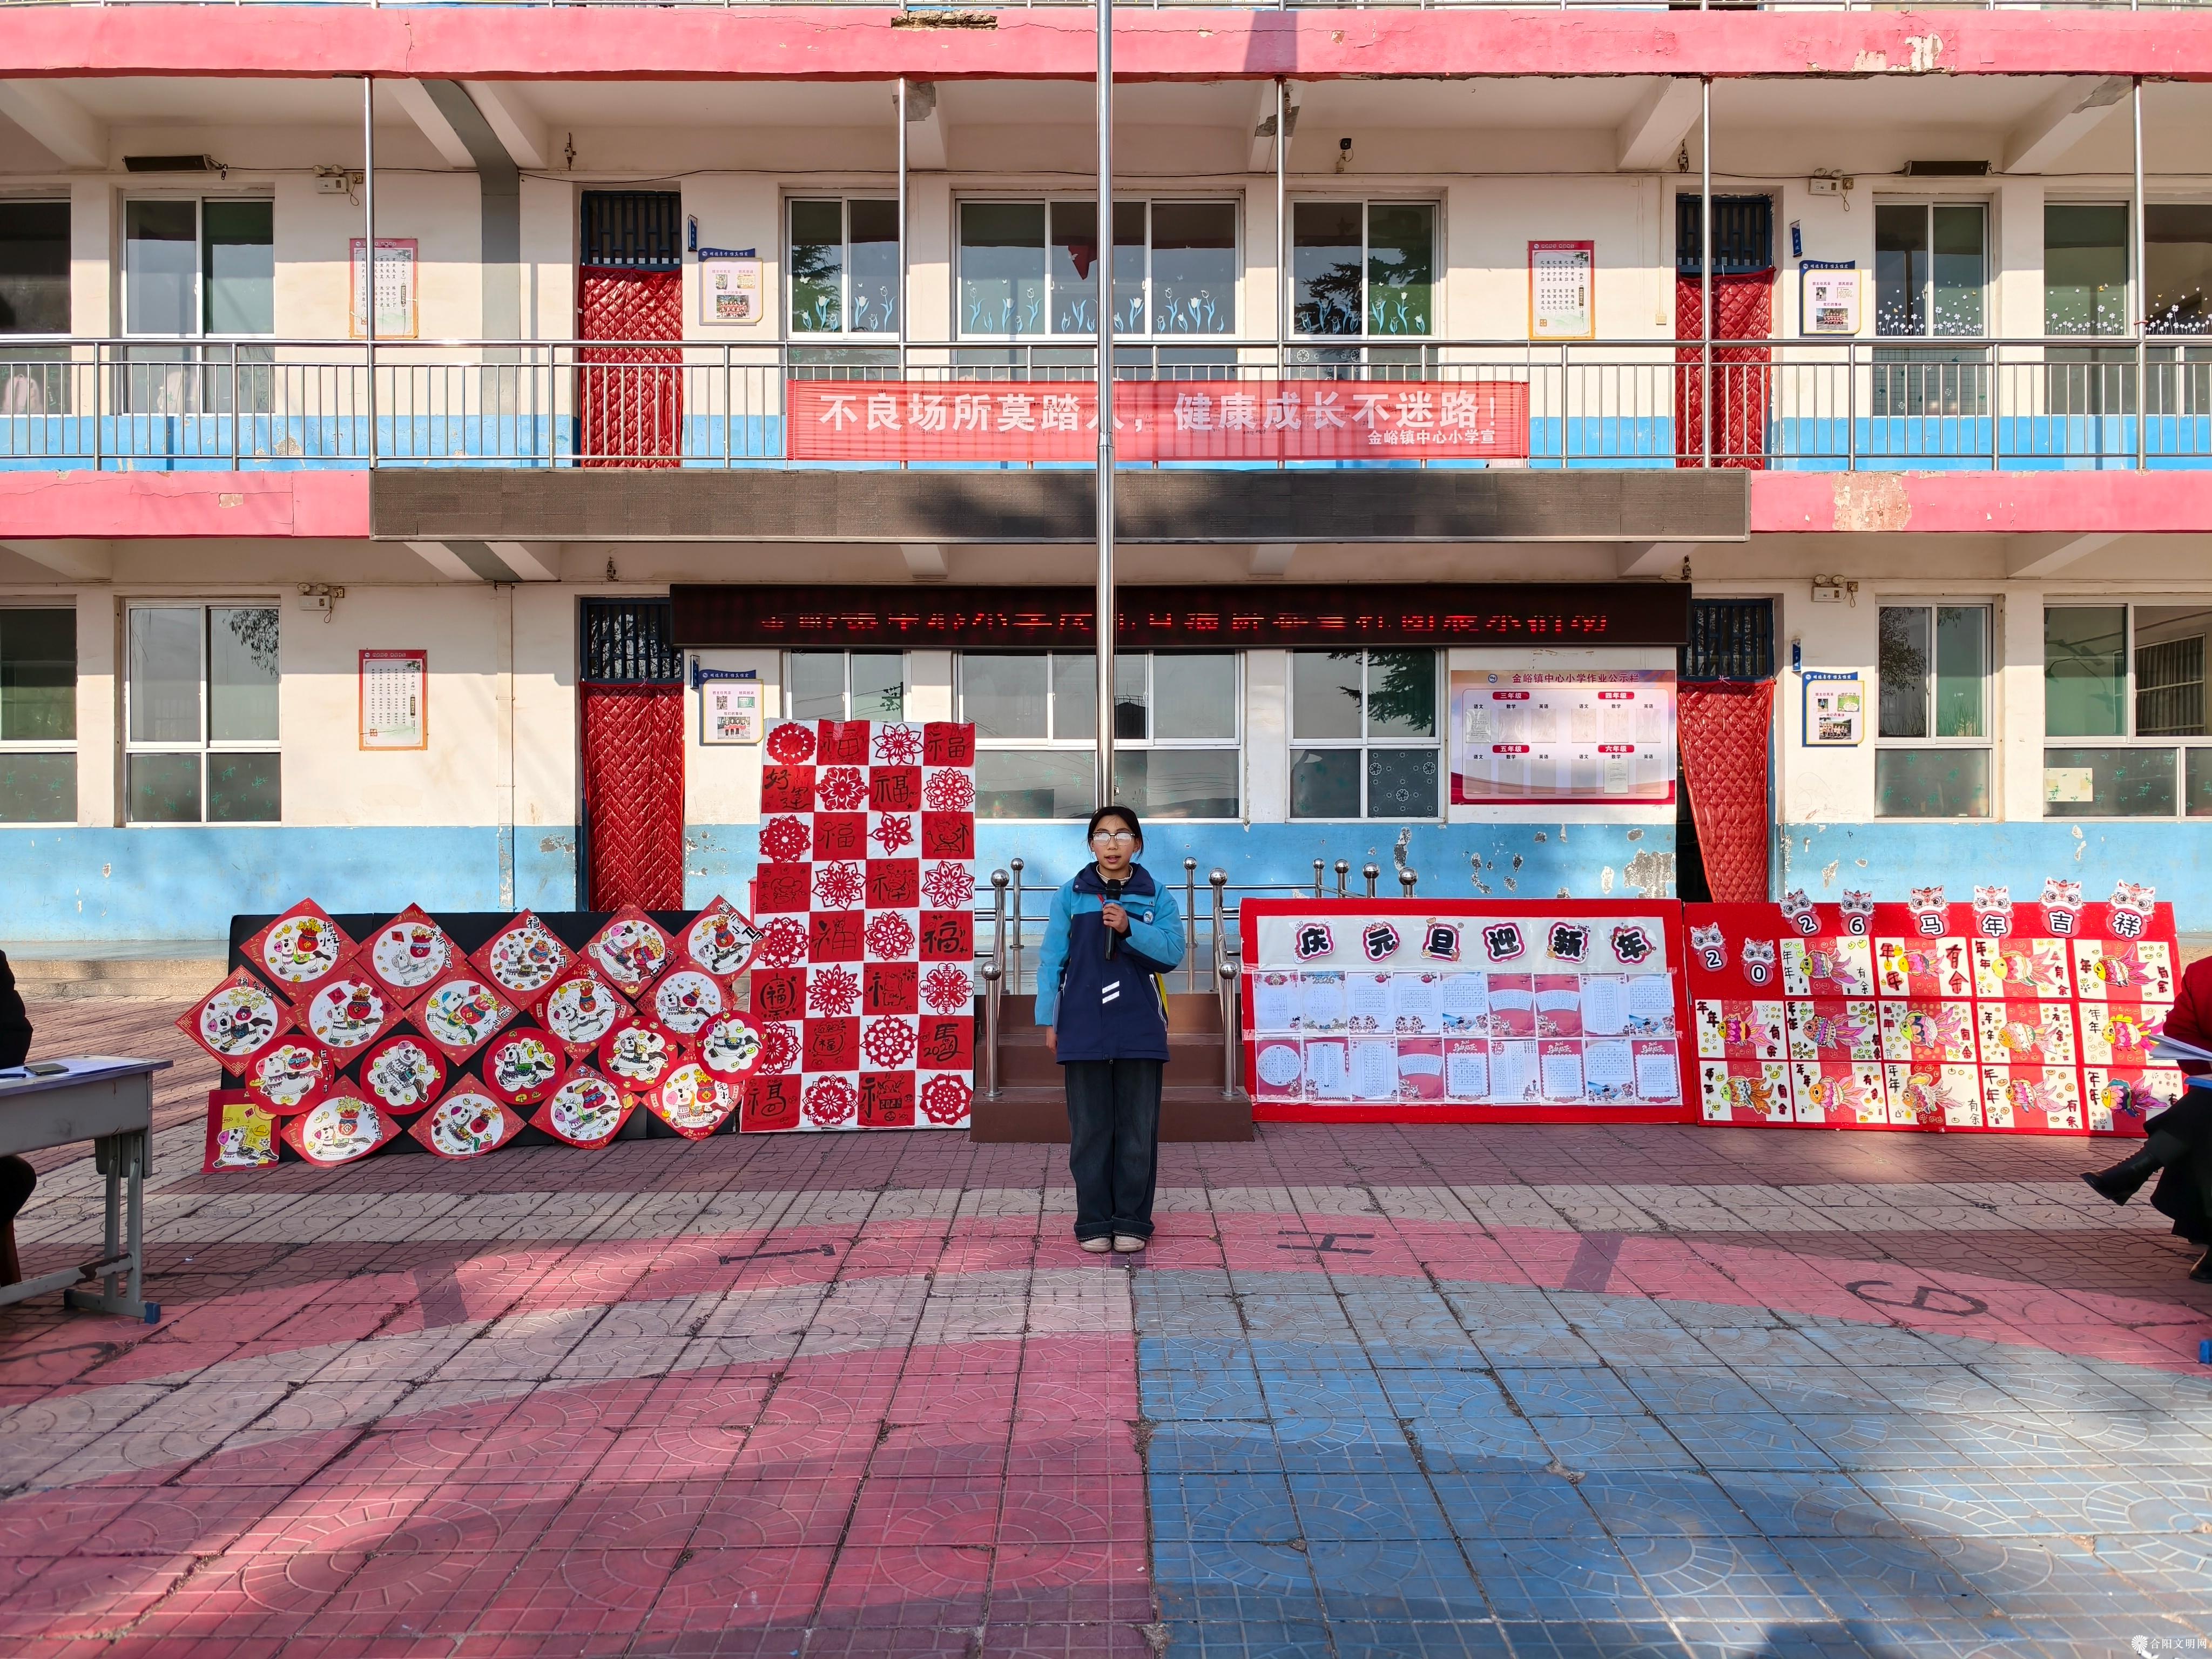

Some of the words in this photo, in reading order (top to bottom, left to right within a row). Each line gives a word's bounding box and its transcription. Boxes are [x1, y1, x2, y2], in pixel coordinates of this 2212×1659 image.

[1368, 429, 1496, 445] 金峪镇中心小学宣
[1512, 673, 1640, 683] 金峪镇中心小学作业公示栏
[928, 732, 965, 761] 福
[873, 775, 909, 803] 福
[817, 821, 854, 849] 福
[922, 921, 960, 953] 福
[1783, 950, 1795, 980] 年年
[767, 984, 786, 1004] 福
[1857, 967, 1870, 995] 有余
[2088, 1008, 2102, 1034] 年年
[818, 1038, 835, 1051] 福
[1888, 1064, 1900, 1093] 年年
[1984, 1068, 1999, 1103] 年年
[880, 1097, 901, 1109] 2026
[1967, 1098, 1980, 1125] 有余
